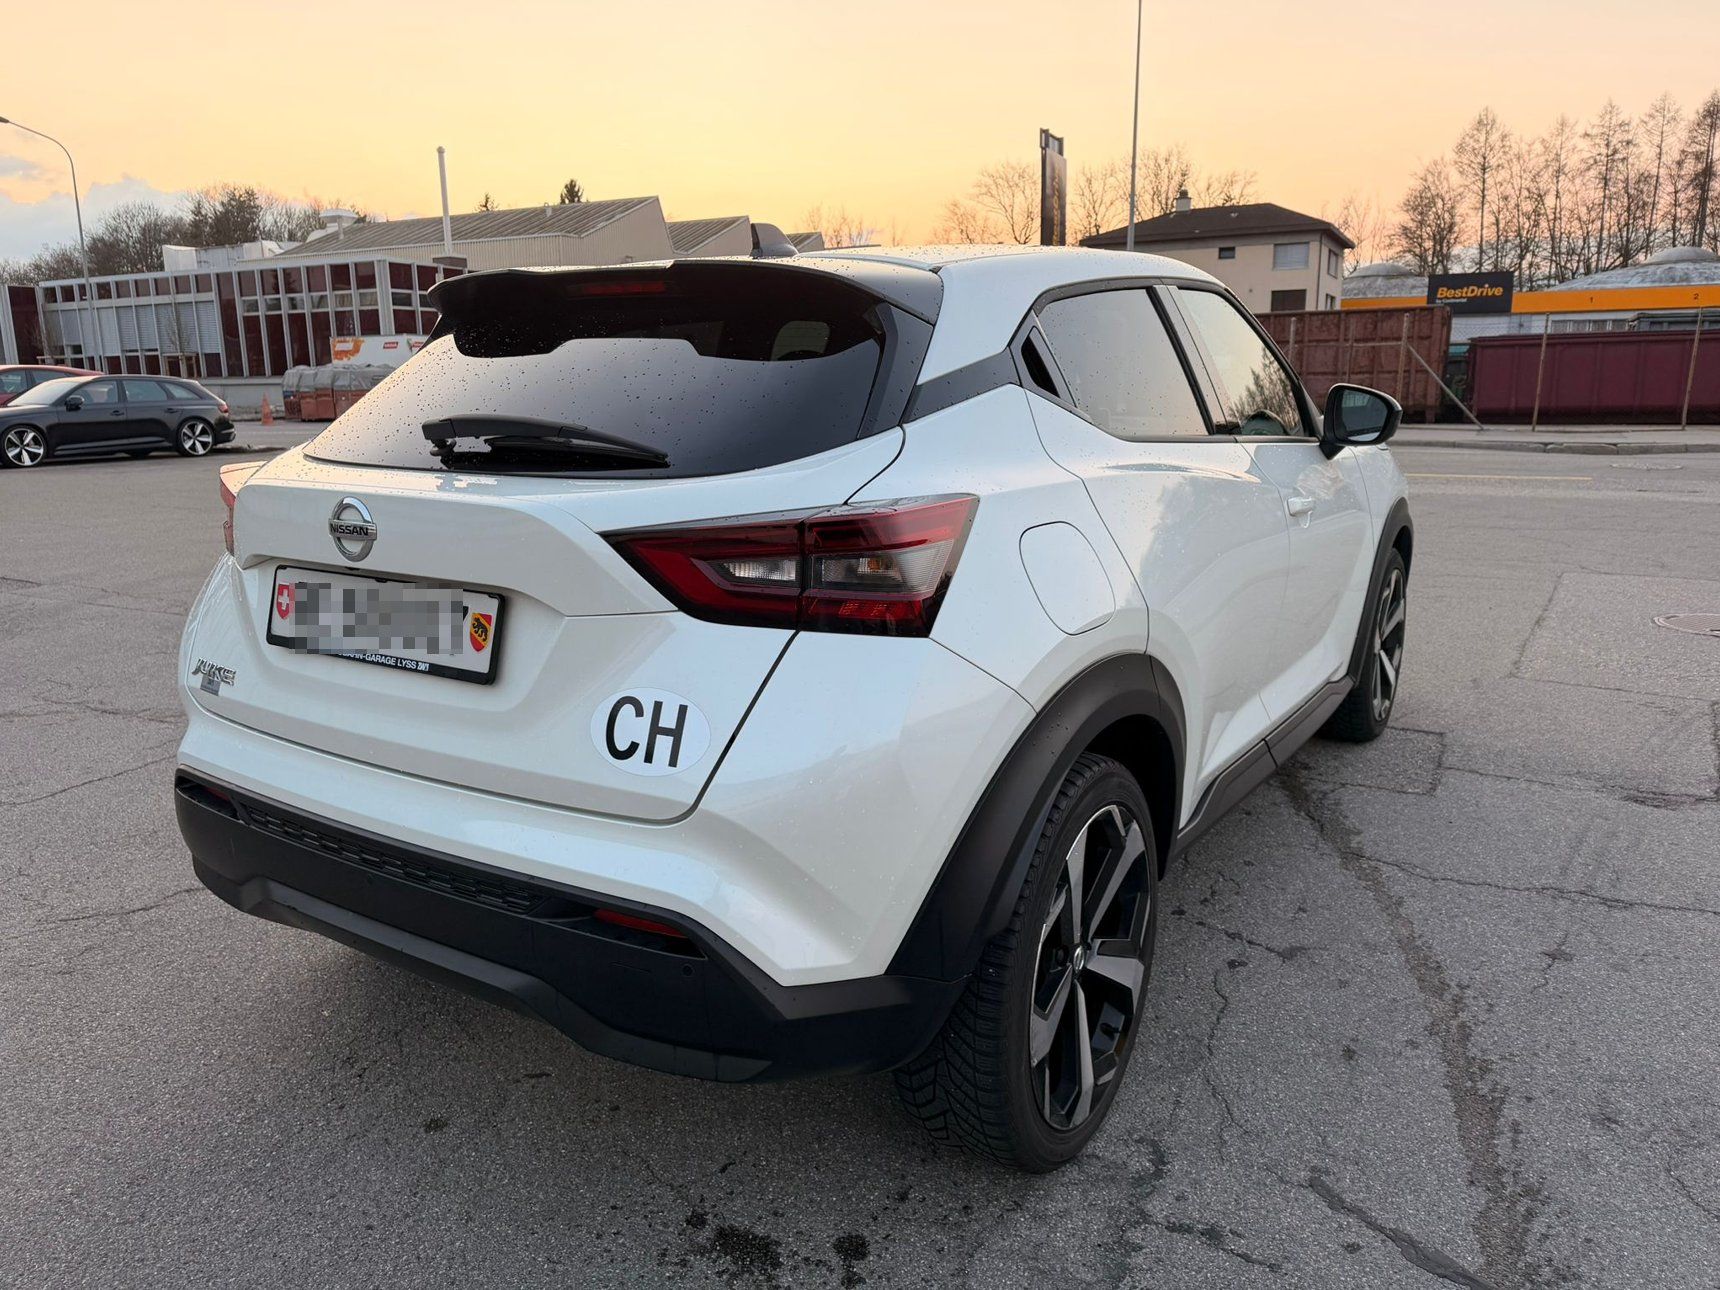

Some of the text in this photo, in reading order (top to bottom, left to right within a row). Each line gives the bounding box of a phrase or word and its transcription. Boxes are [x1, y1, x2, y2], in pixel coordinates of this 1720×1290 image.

[1436, 284, 1504, 298] BestDrive
[330, 523, 369, 536] NISSAN
[397, 659, 417, 669] LYSS
[191, 658, 237, 686] JUKE
[605, 695, 688, 768] CH
